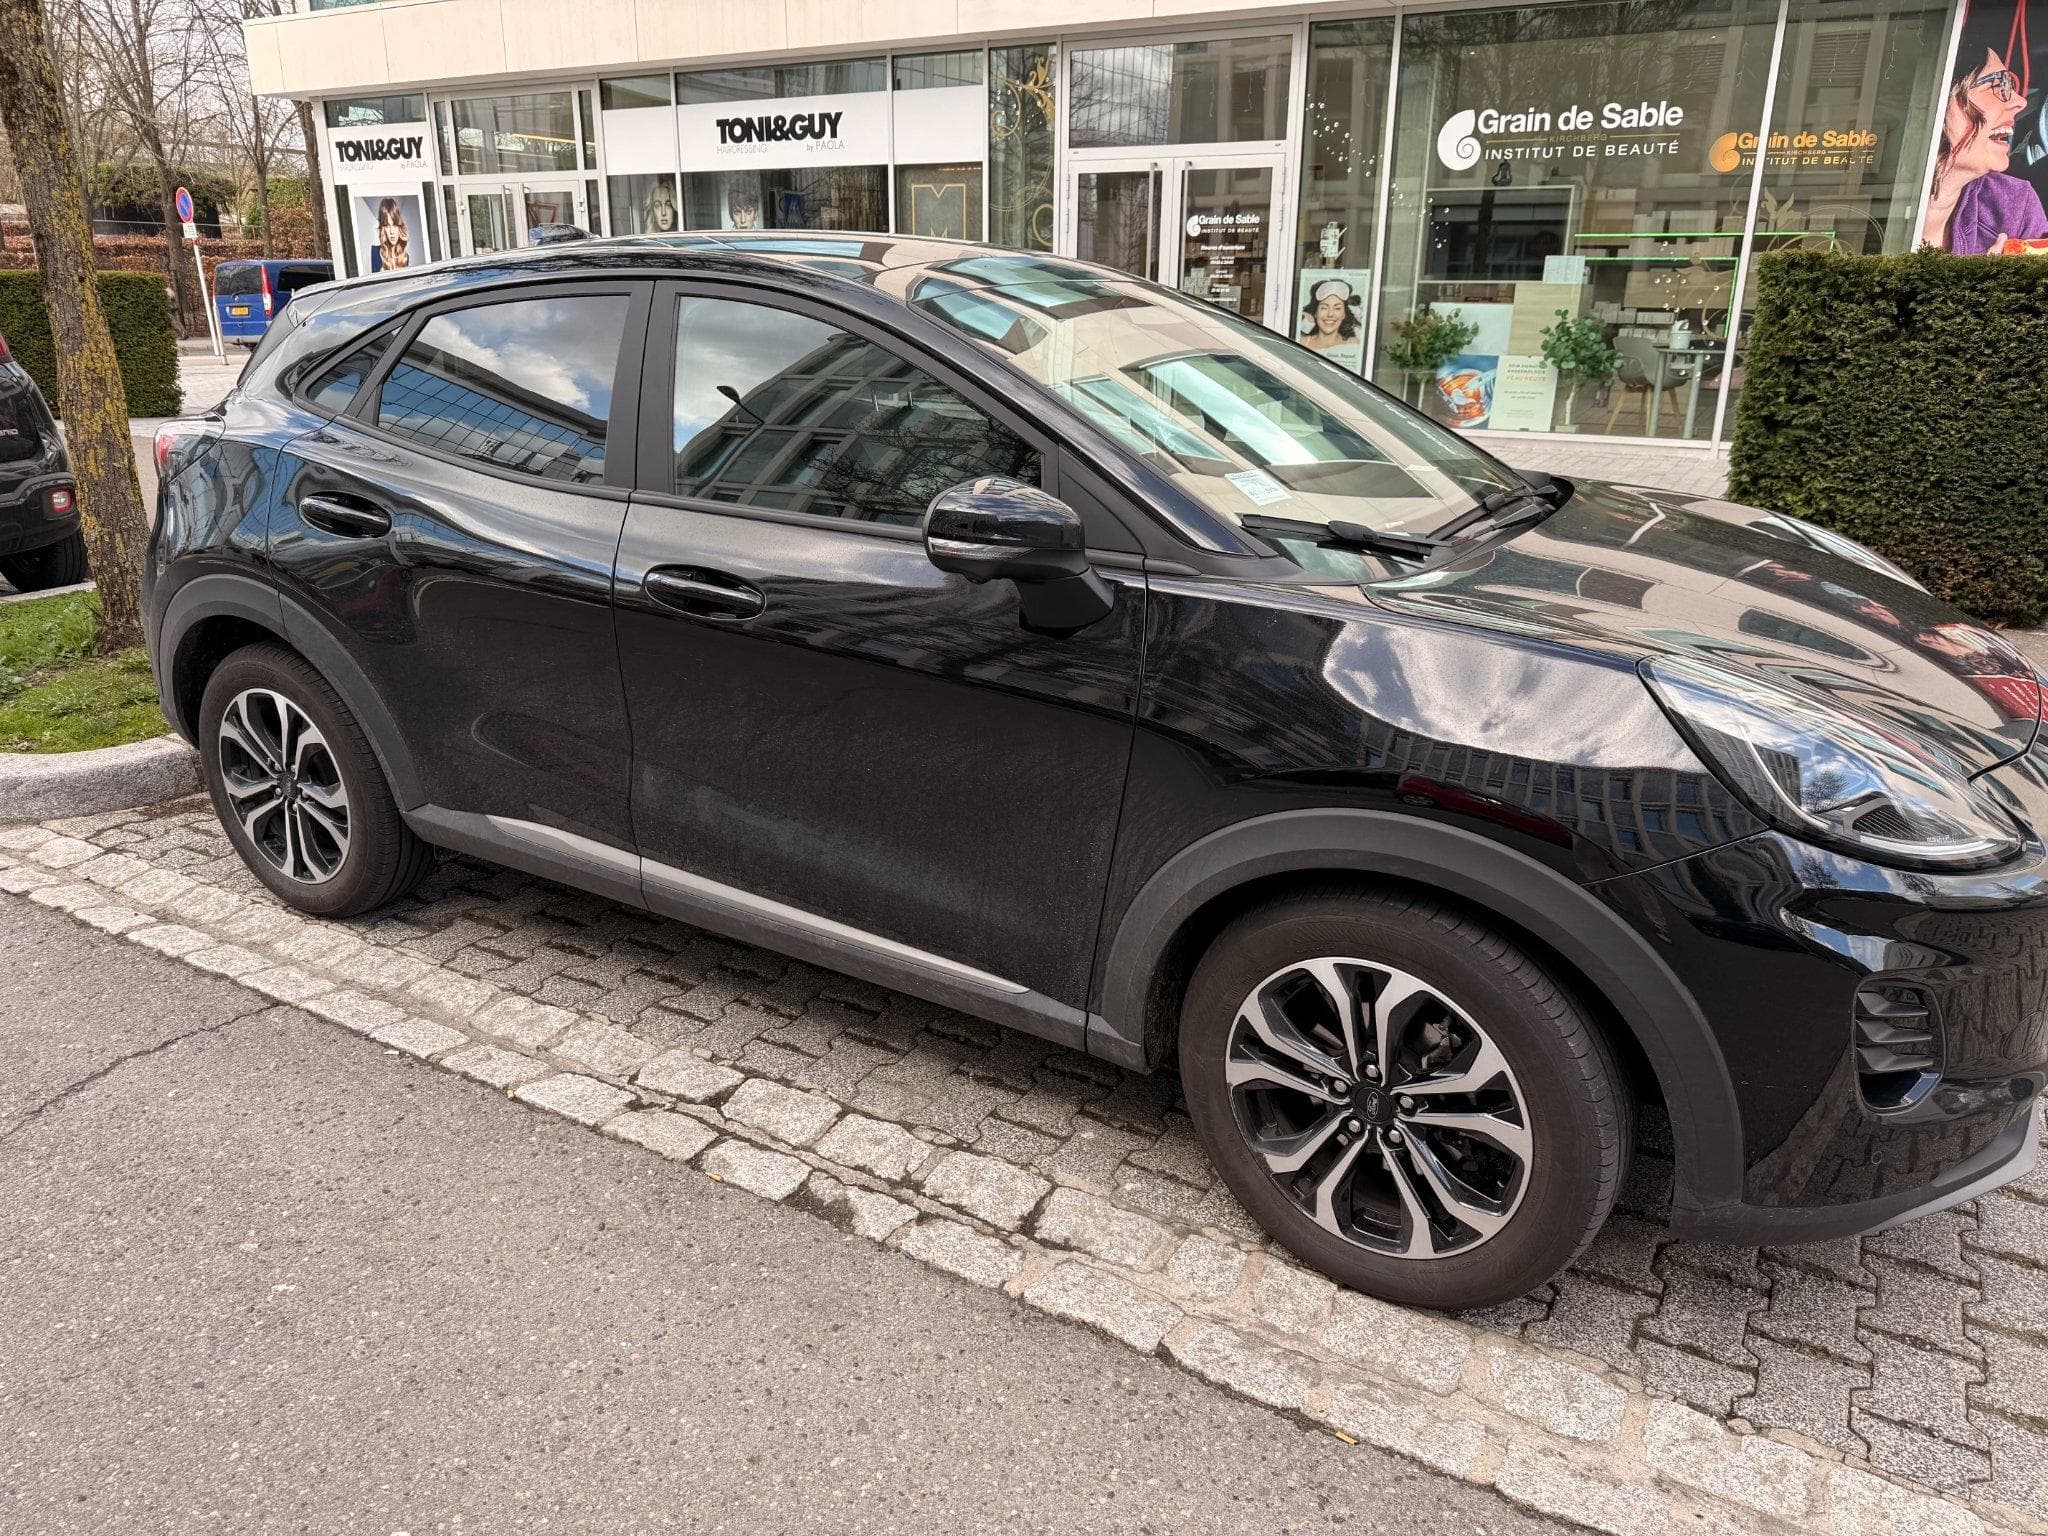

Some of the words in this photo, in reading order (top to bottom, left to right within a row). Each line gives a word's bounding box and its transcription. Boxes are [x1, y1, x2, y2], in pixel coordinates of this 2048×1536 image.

[1478, 107, 1551, 134] Grain
[1558, 104, 1594, 131] de
[1600, 100, 1684, 129] Sable
[716, 111, 843, 144] TONI&GUY
[335, 136, 423, 162] TONI&GUY
[1737, 132, 1789, 149] Grin
[1793, 131, 1818, 148] de
[1822, 129, 1878, 148] Sable
[1485, 146, 1565, 160] INSTITUT
[1573, 145, 1596, 157] DE
[1605, 140, 1679, 156] BEAUTÉ
[1802, 157, 1818, 165] DE
[1199, 214, 1221, 225] Grain
[1223, 214, 1234, 225] de
[1235, 213, 1260, 224] Sable
